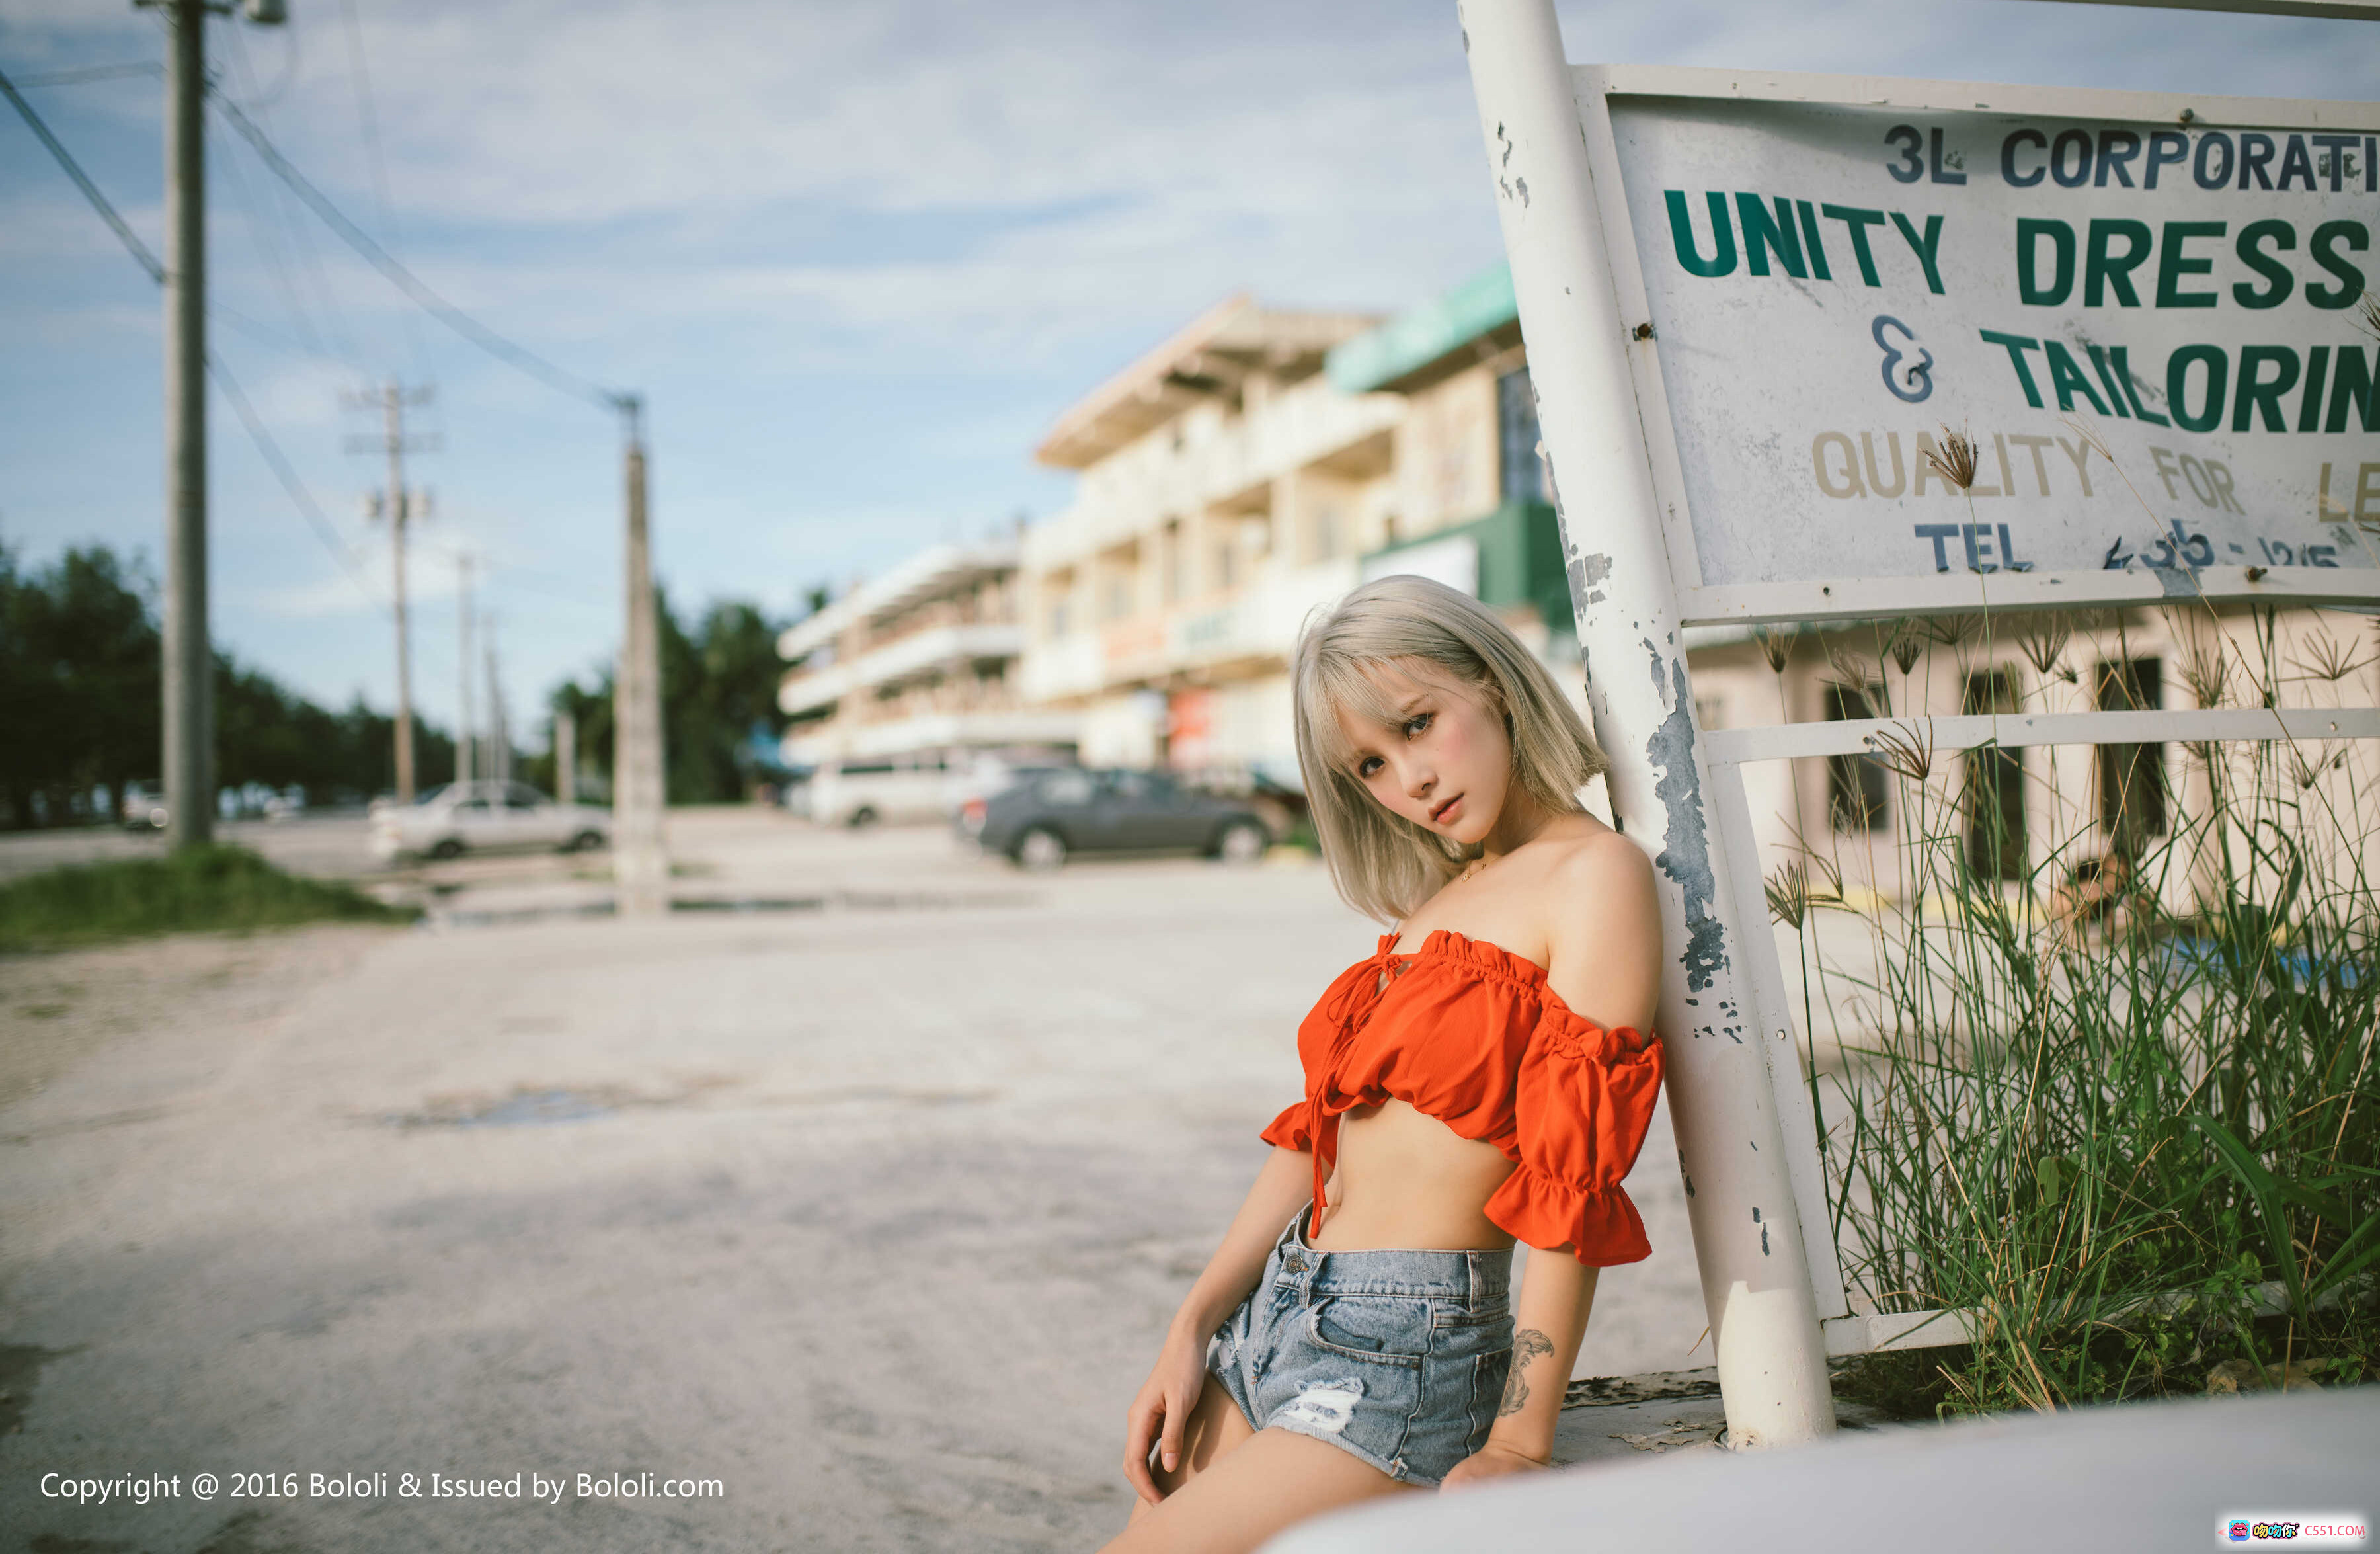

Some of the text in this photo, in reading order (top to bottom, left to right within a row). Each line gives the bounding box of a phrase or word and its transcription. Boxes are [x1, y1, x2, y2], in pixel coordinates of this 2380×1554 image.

[1884, 124, 2378, 192] 3L CORPORATI
[1664, 190, 2371, 310] UNITY DRESS
[1872, 315, 2380, 434] & TAILORIN
[2150, 446, 2246, 516] FOR
[1914, 523, 2034, 573] TEL
